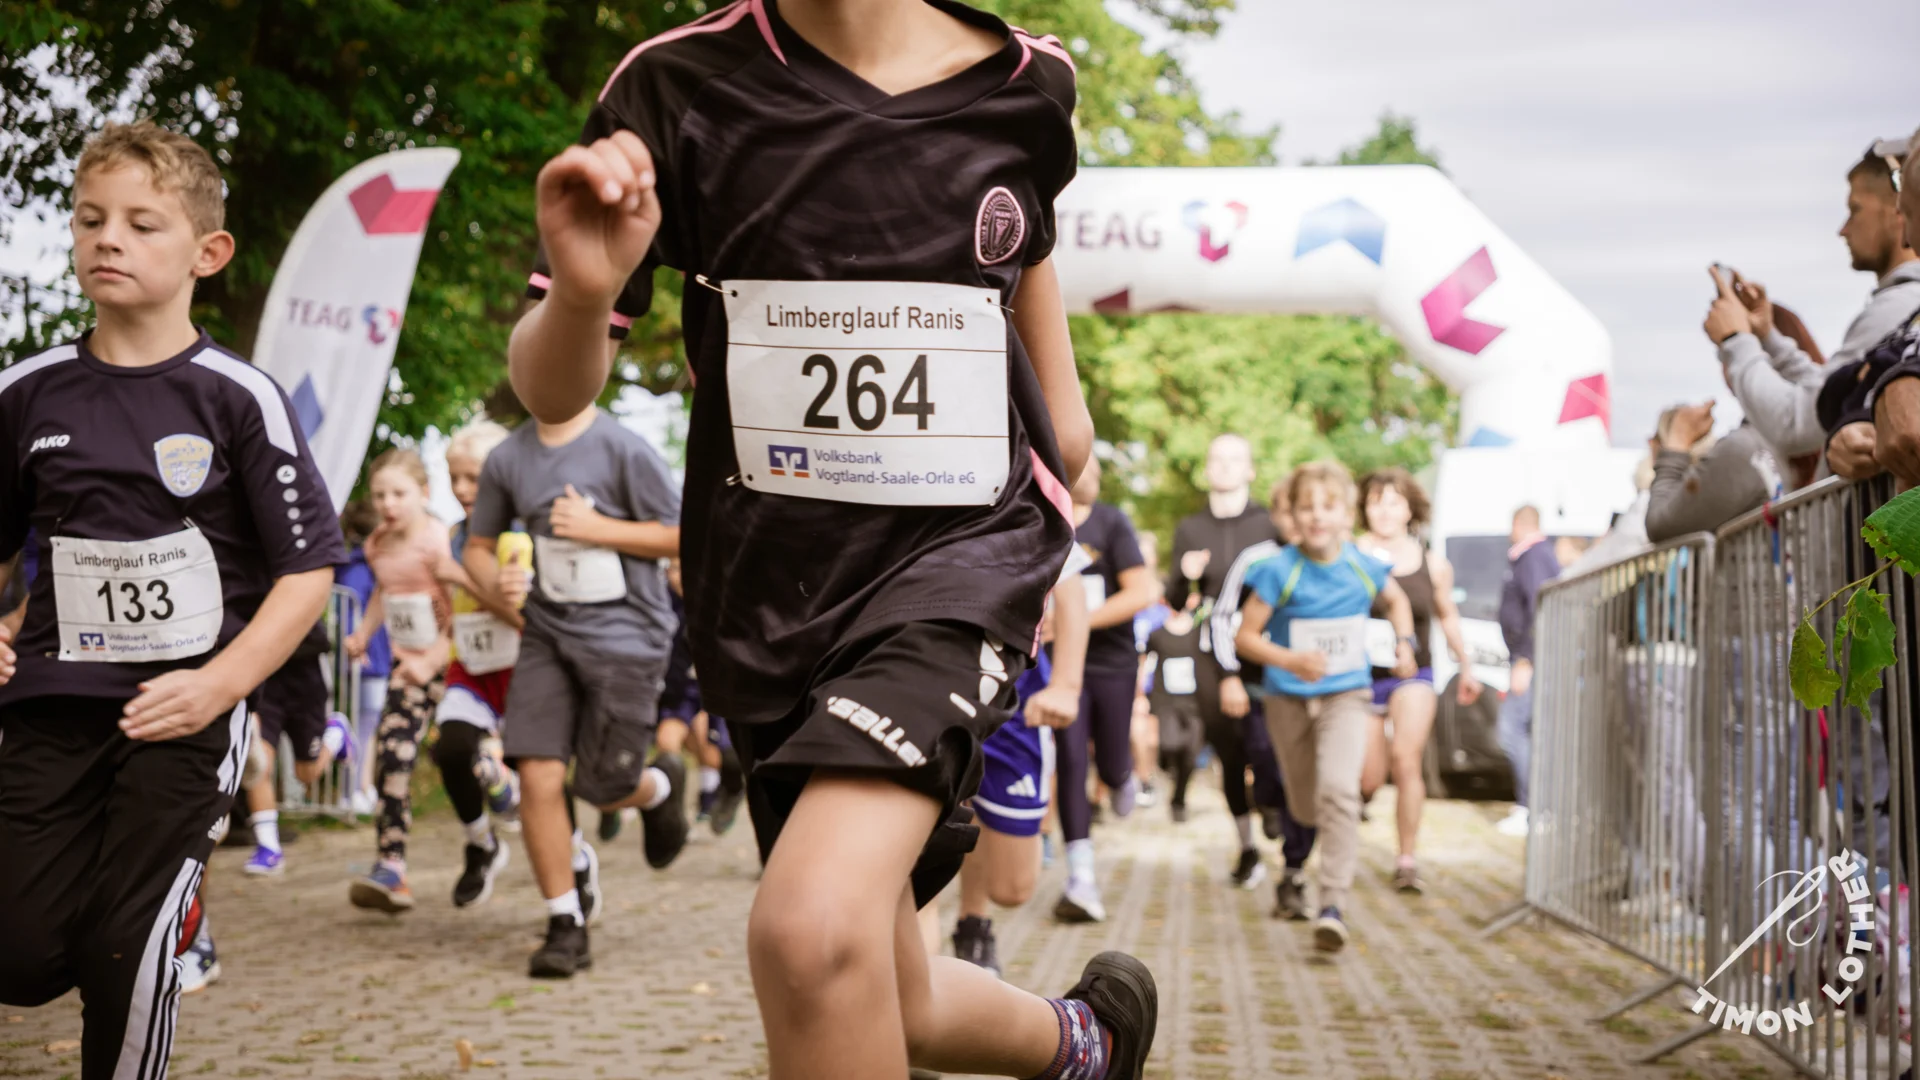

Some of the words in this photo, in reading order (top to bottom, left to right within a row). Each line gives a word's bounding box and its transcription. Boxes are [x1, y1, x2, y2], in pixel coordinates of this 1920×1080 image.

[1055, 212, 1160, 250] TEAG
[766, 305, 899, 334] Limberglauf
[908, 306, 965, 330] Ranis
[802, 353, 936, 431] 264
[30, 434, 71, 453] JAKO
[813, 448, 883, 465] Volksbank
[815, 468, 955, 486] Vogtland-Saale-Orla
[958, 471, 976, 485] eG
[74, 552, 144, 571] Limberglauf
[148, 547, 187, 566] Ranis
[97, 579, 174, 623] 133
